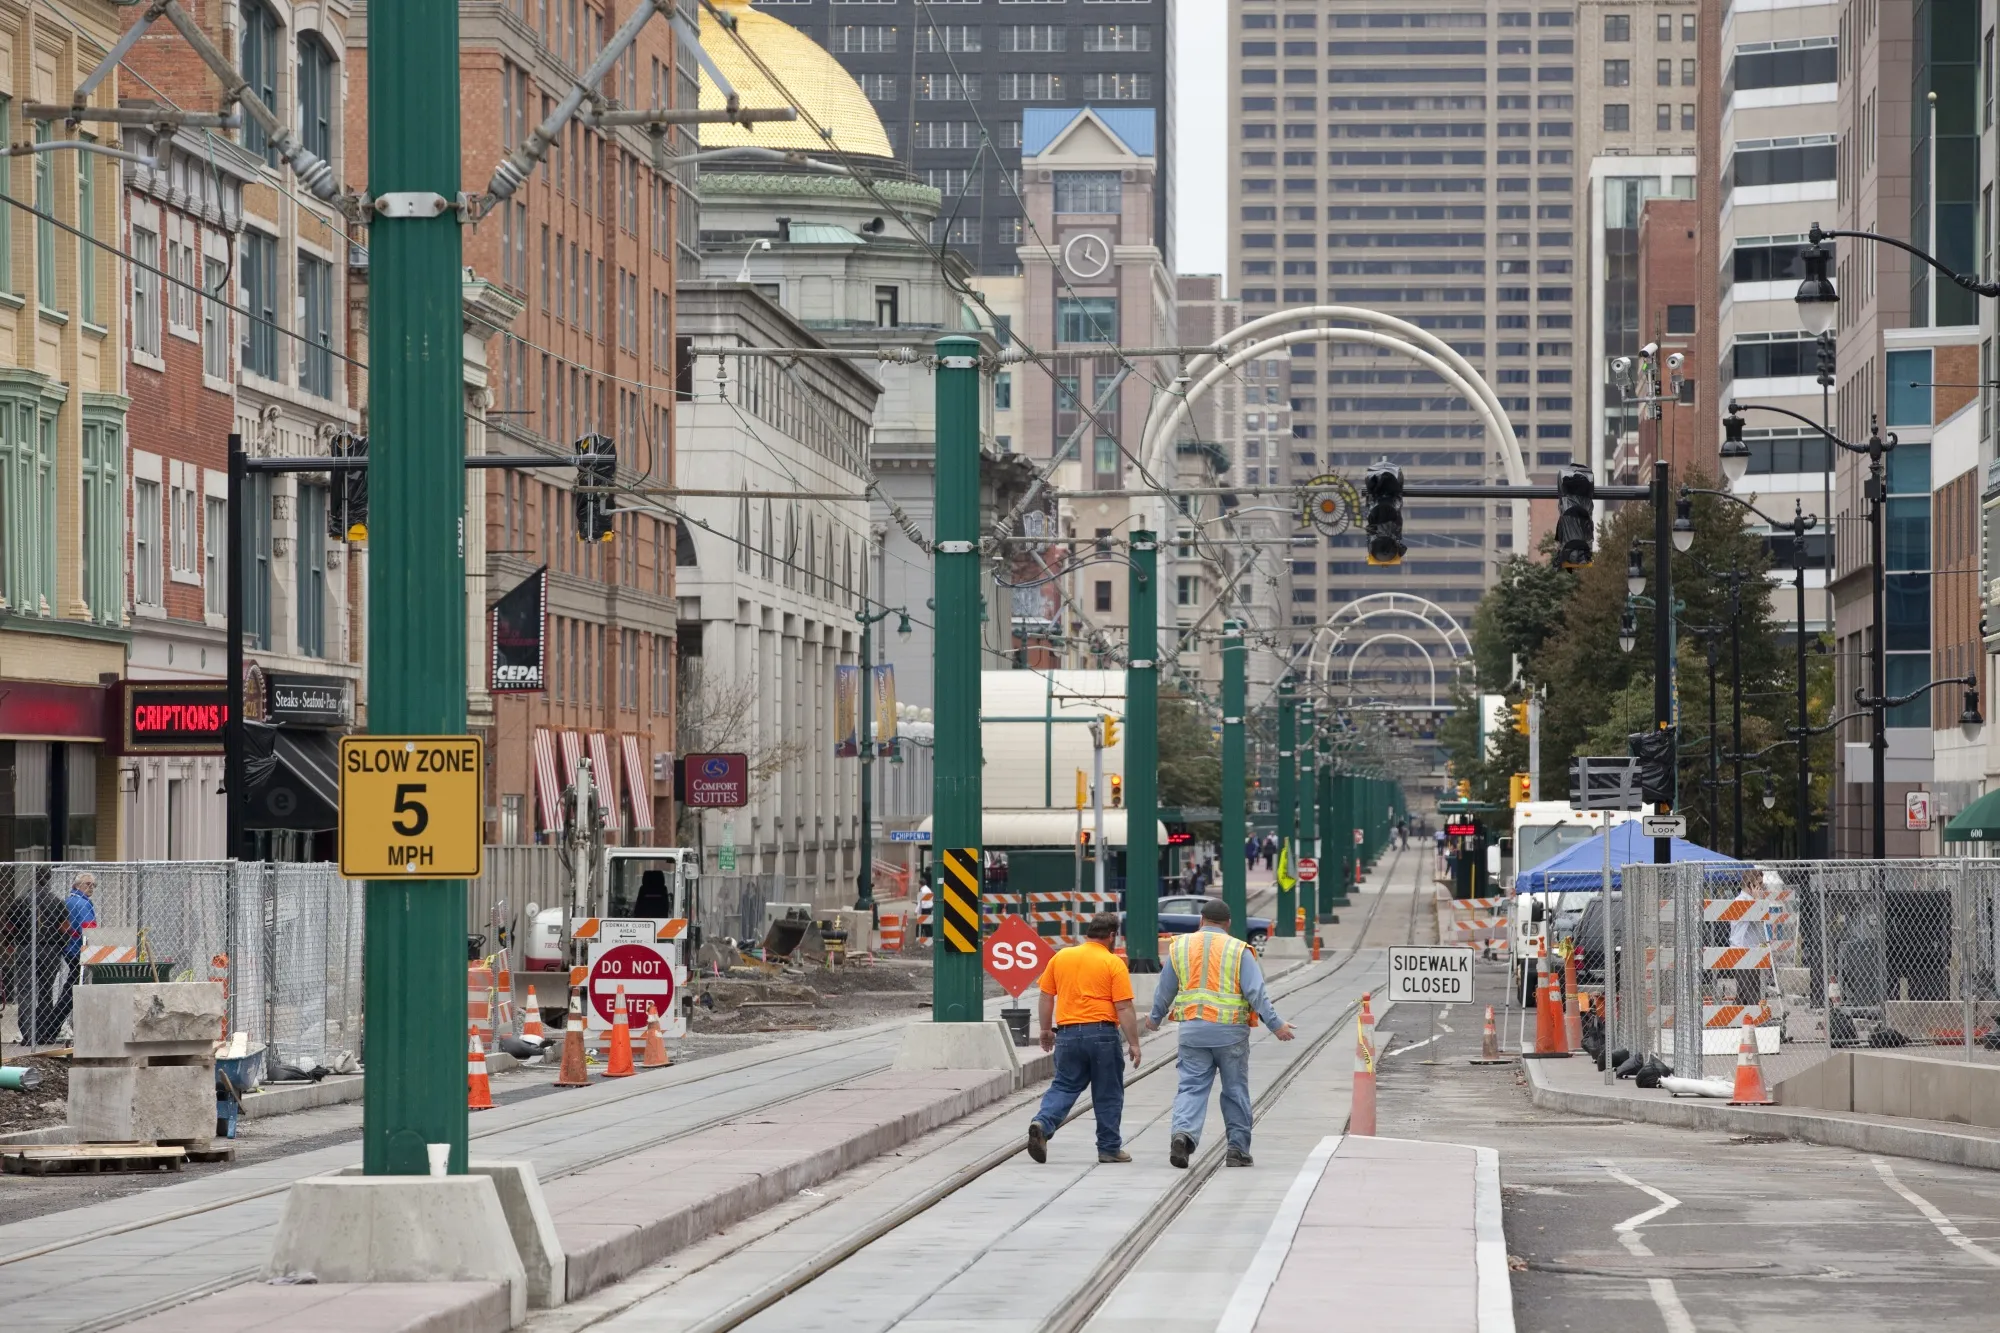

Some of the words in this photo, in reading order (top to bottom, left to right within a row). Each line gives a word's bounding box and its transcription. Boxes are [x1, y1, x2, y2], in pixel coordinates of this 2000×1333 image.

[497, 665, 538, 680] CEPA
[275, 690, 298, 708] Steaks
[135, 705, 219, 731] CRIPTIONS
[347, 749, 410, 773] SLOW
[416, 749, 475, 773] ZONE
[694, 792, 738, 803] SUITES
[392, 784, 428, 836] 5
[1970, 829, 1982, 838] 600
[388, 846, 433, 866] MPH
[992, 941, 1038, 970] SS
[1394, 955, 1468, 972] SIDEWALK
[602, 961, 621, 974] DO
[632, 961, 661, 974] NOT
[1403, 977, 1460, 993] CLOSED
[606, 999, 655, 1012] ETER
